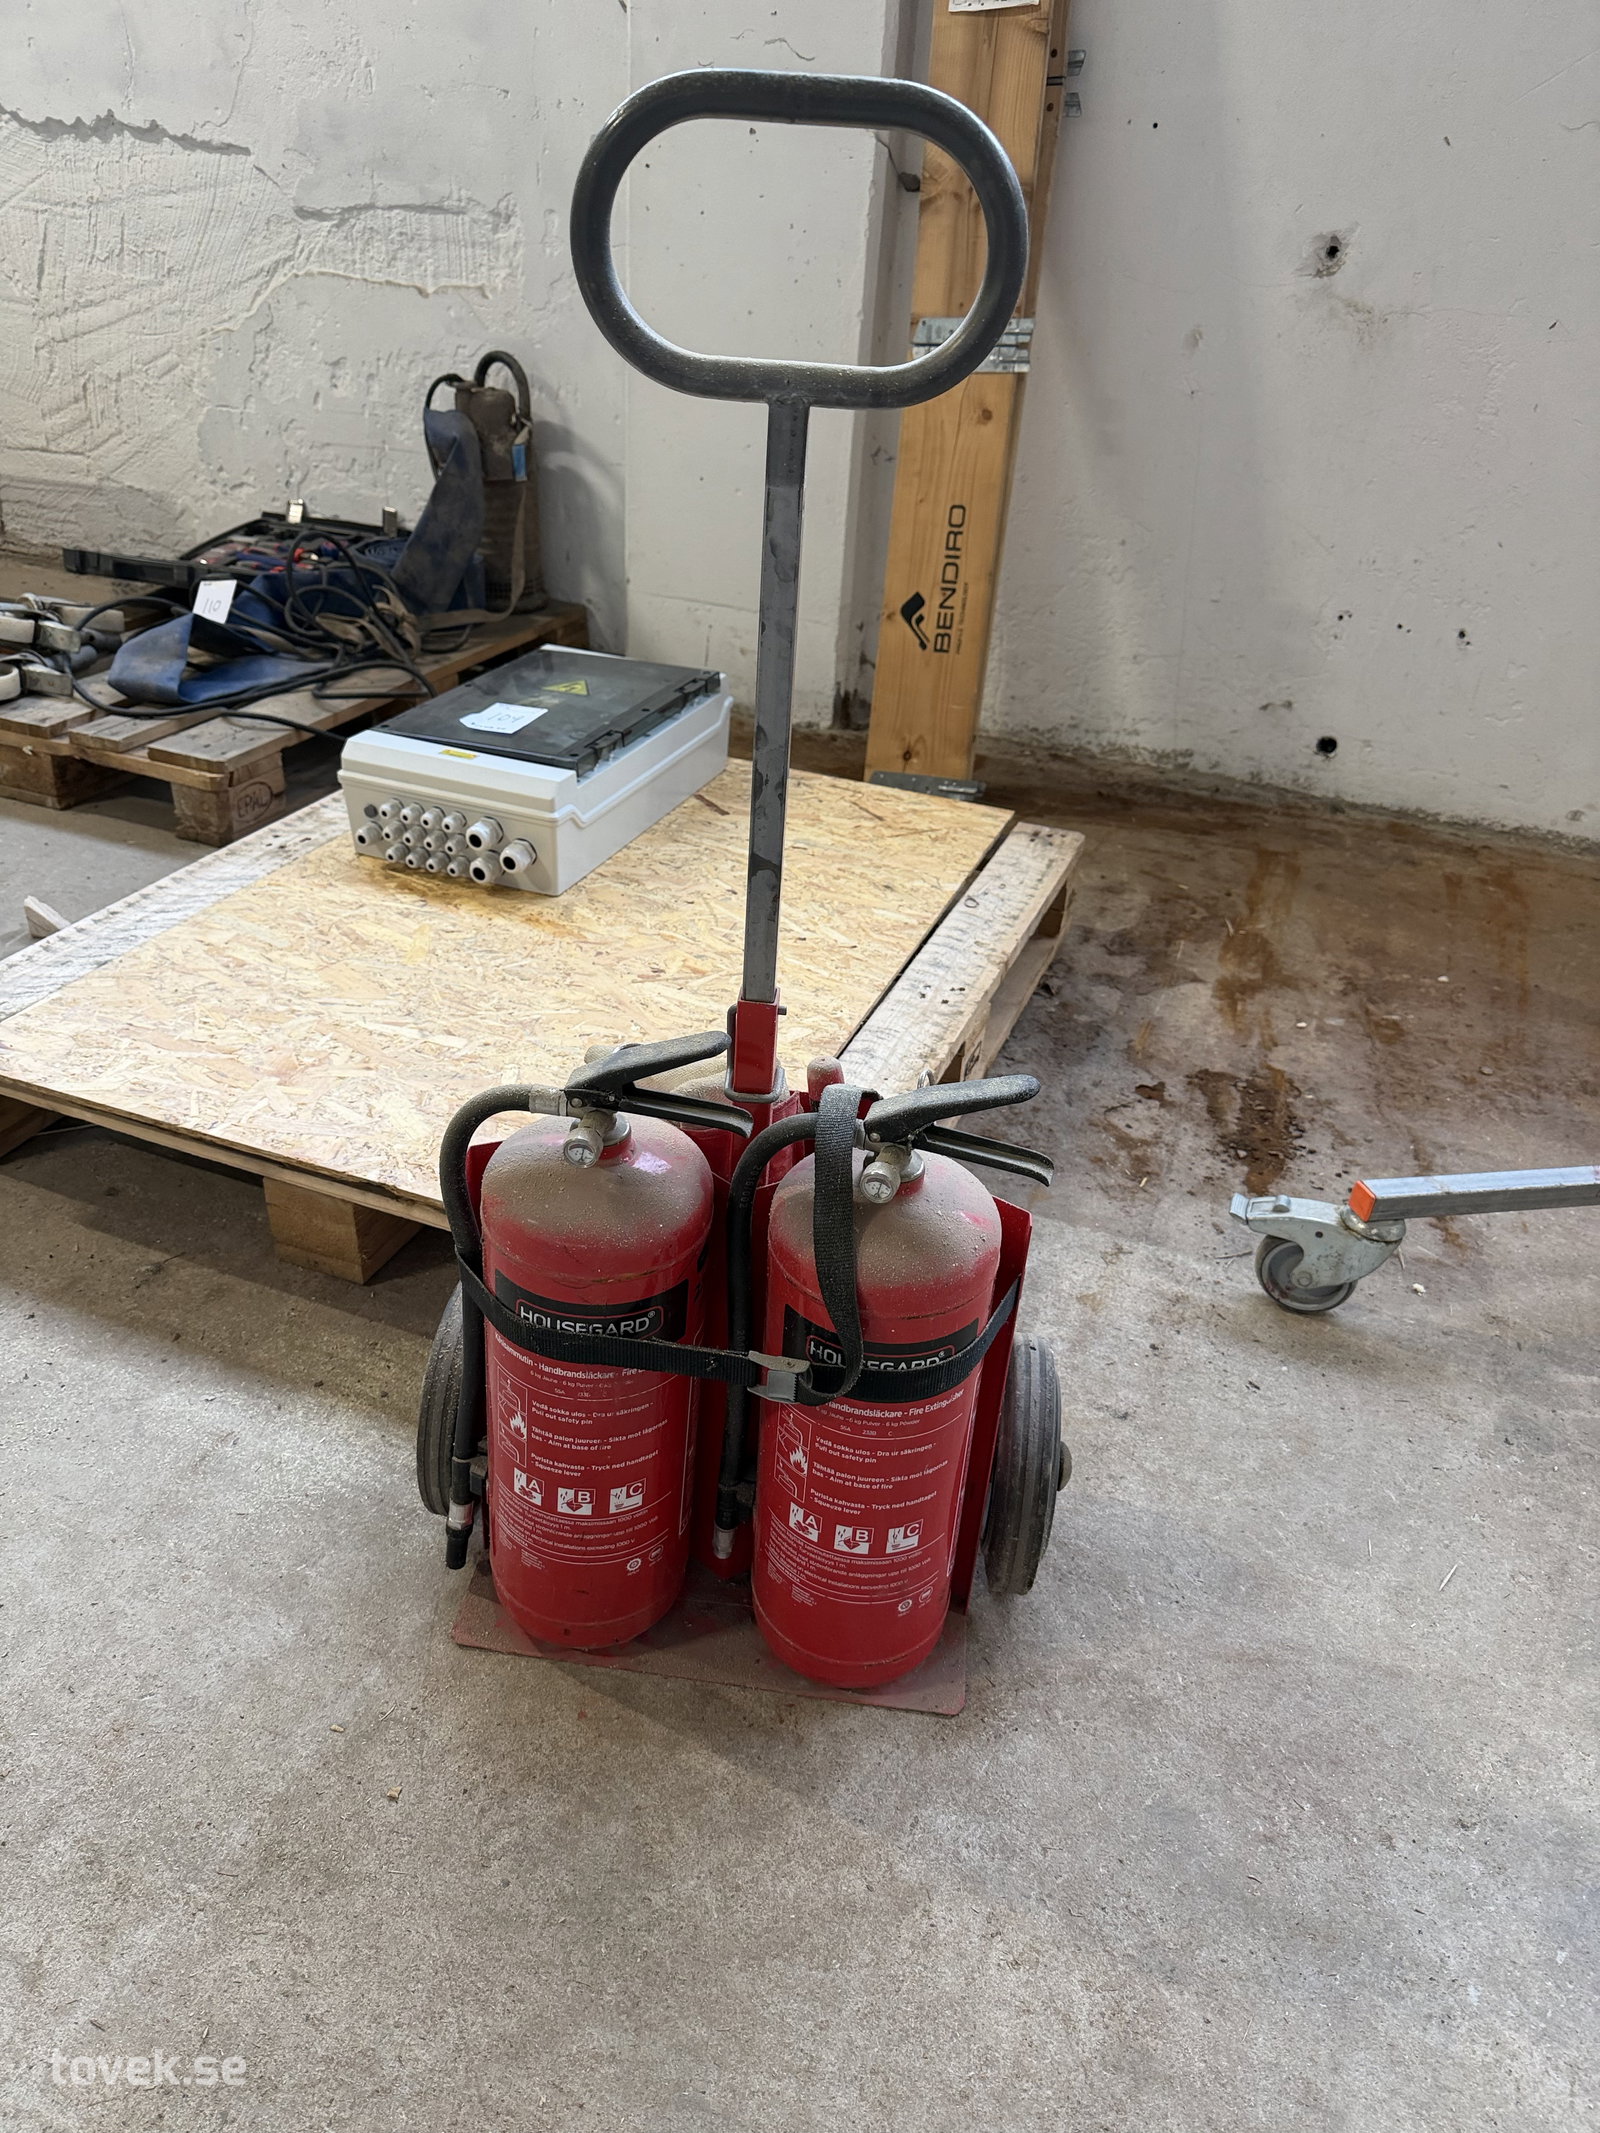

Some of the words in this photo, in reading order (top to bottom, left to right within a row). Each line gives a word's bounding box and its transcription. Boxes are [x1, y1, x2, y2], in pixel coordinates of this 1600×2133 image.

[933, 504, 967, 653] BENDIRO
[202, 598, 222, 614] 110
[532, 1400, 548, 1410] Vedä
[549, 1406, 569, 1416] sokka
[616, 1403, 649, 1416] säkringen
[909, 1407, 924, 1417] Fire
[532, 1407, 544, 1417] Pull
[545, 1412, 557, 1420] out
[557, 1415, 579, 1424] safety
[863, 1419, 881, 1427] Pulver
[900, 1418, 920, 1426] Powder
[531, 1426, 553, 1438] Tähtää
[554, 1433, 574, 1442] palon
[609, 1435, 626, 1443] Sikta
[627, 1431, 642, 1439] mot
[642, 1419, 668, 1435] lågornas
[531, 1433, 543, 1442] bas
[815, 1443, 827, 1453] Pull
[828, 1448, 841, 1456] out
[842, 1452, 864, 1463] safety
[816, 1436, 832, 1446] Vedä
[833, 1443, 854, 1454] sokka
[855, 1448, 870, 1456] ulos
[900, 1443, 933, 1456] säkringen
[531, 1453, 553, 1465] Purista
[554, 1460, 585, 1470] kahvasta
[612, 1461, 625, 1469] ned
[626, 1450, 659, 1465] handtaget
[535, 1462, 562, 1474] Squeeze
[563, 1468, 581, 1477] lever
[813, 1462, 835, 1475] Tähtää
[836, 1470, 856, 1481] palon
[857, 1475, 885, 1483] juureen
[891, 1474, 908, 1482] Sikta
[909, 1471, 922, 1479] mot
[528, 1479, 540, 1493] A
[812, 1469, 824, 1478] bas
[830, 1476, 844, 1485] Aim
[853, 1481, 870, 1489] base
[629, 1482, 643, 1496] C
[578, 1491, 591, 1503] B
[810, 1488, 833, 1502] Purista
[834, 1496, 865, 1509] kahvasta
[892, 1501, 905, 1509] ned
[906, 1490, 937, 1506] handtaget
[843, 1506, 861, 1515] lever
[575, 1518, 617, 1526] maksimissaan
[617, 1515, 632, 1523] 1000
[633, 1523, 648, 1531] 1000
[804, 1515, 818, 1529] A
[856, 1530, 869, 1541] B
[906, 1523, 919, 1537] C
[616, 1539, 630, 1548] 1000
[851, 1557, 892, 1566] maksimissaan
[893, 1555, 906, 1563] 1000
[908, 1563, 921, 1573] 1000
